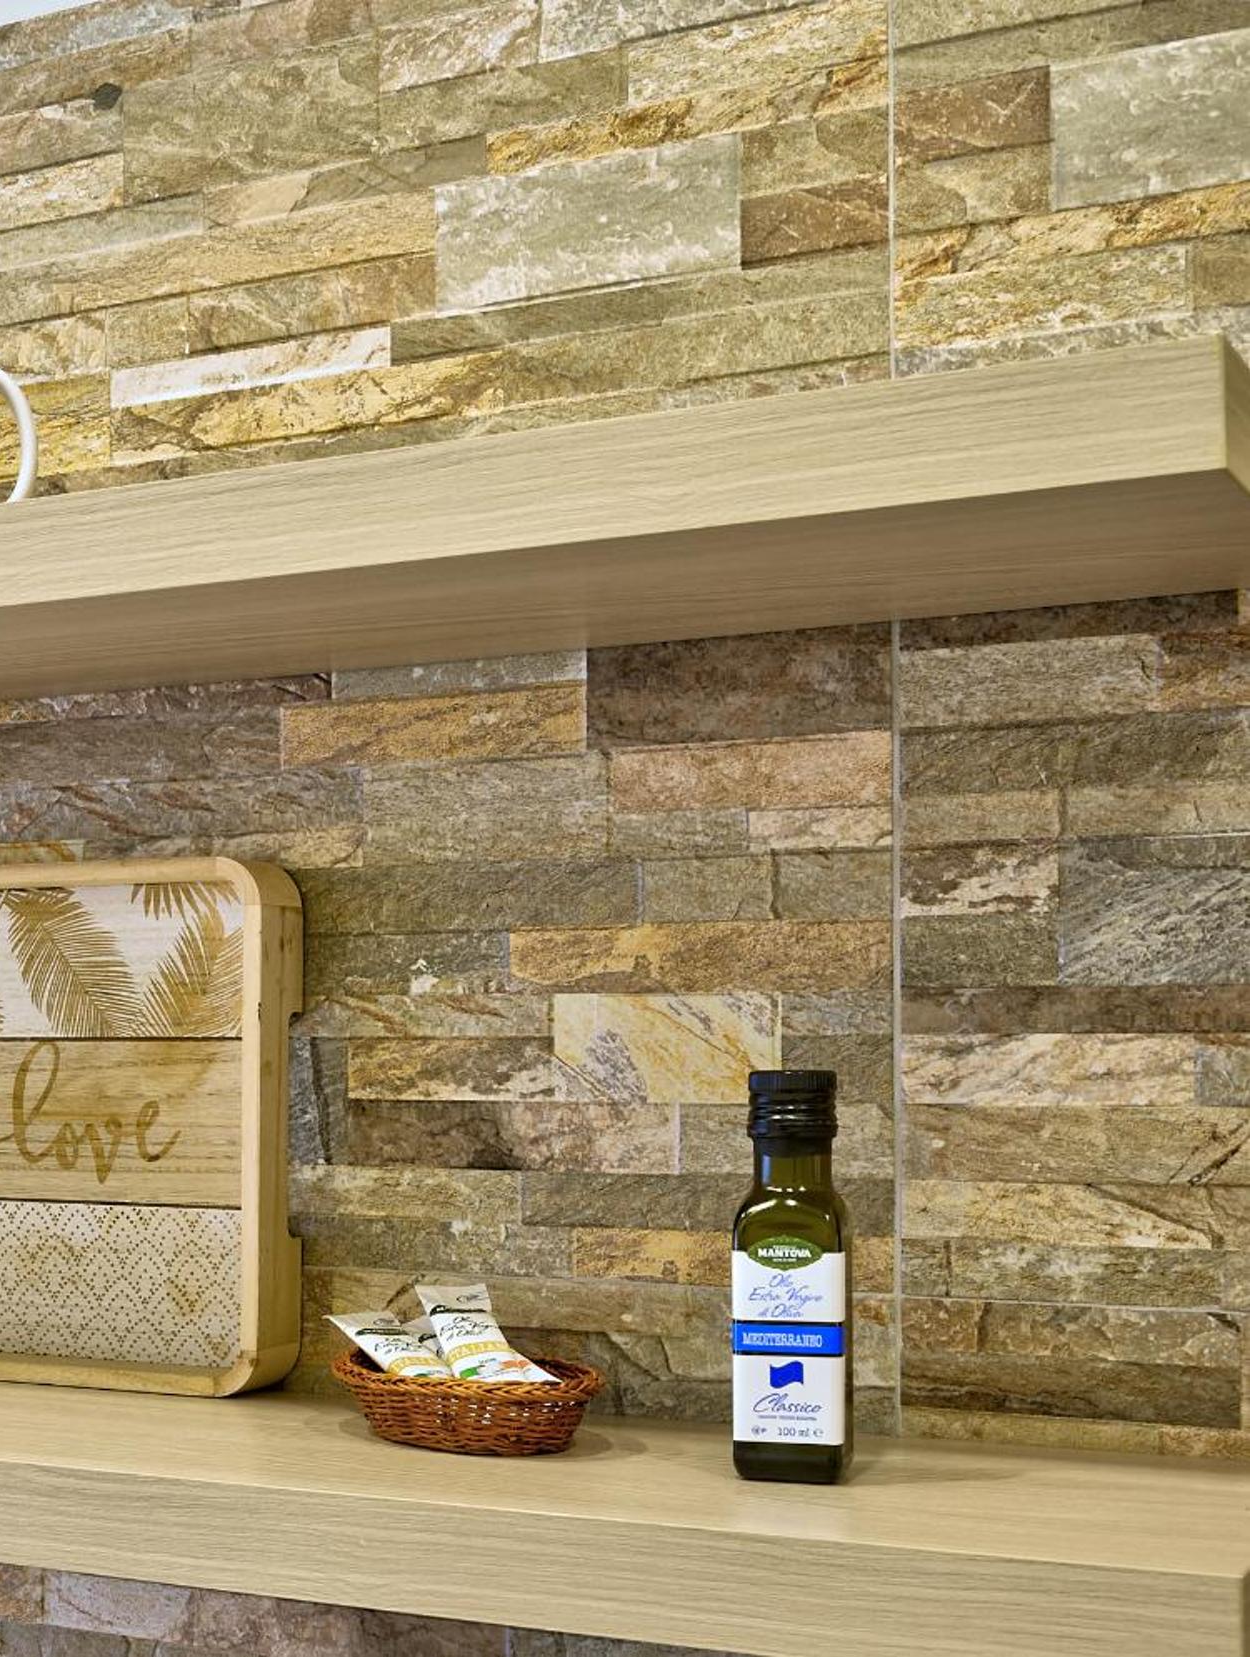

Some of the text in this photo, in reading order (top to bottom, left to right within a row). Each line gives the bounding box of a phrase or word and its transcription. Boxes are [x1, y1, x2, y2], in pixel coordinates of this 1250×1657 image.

[12, 1041, 182, 1184] love
[757, 1248, 812, 1258] MANTOVA
[753, 1392, 822, 1413] Classico
[777, 1427, 796, 1437] 100
